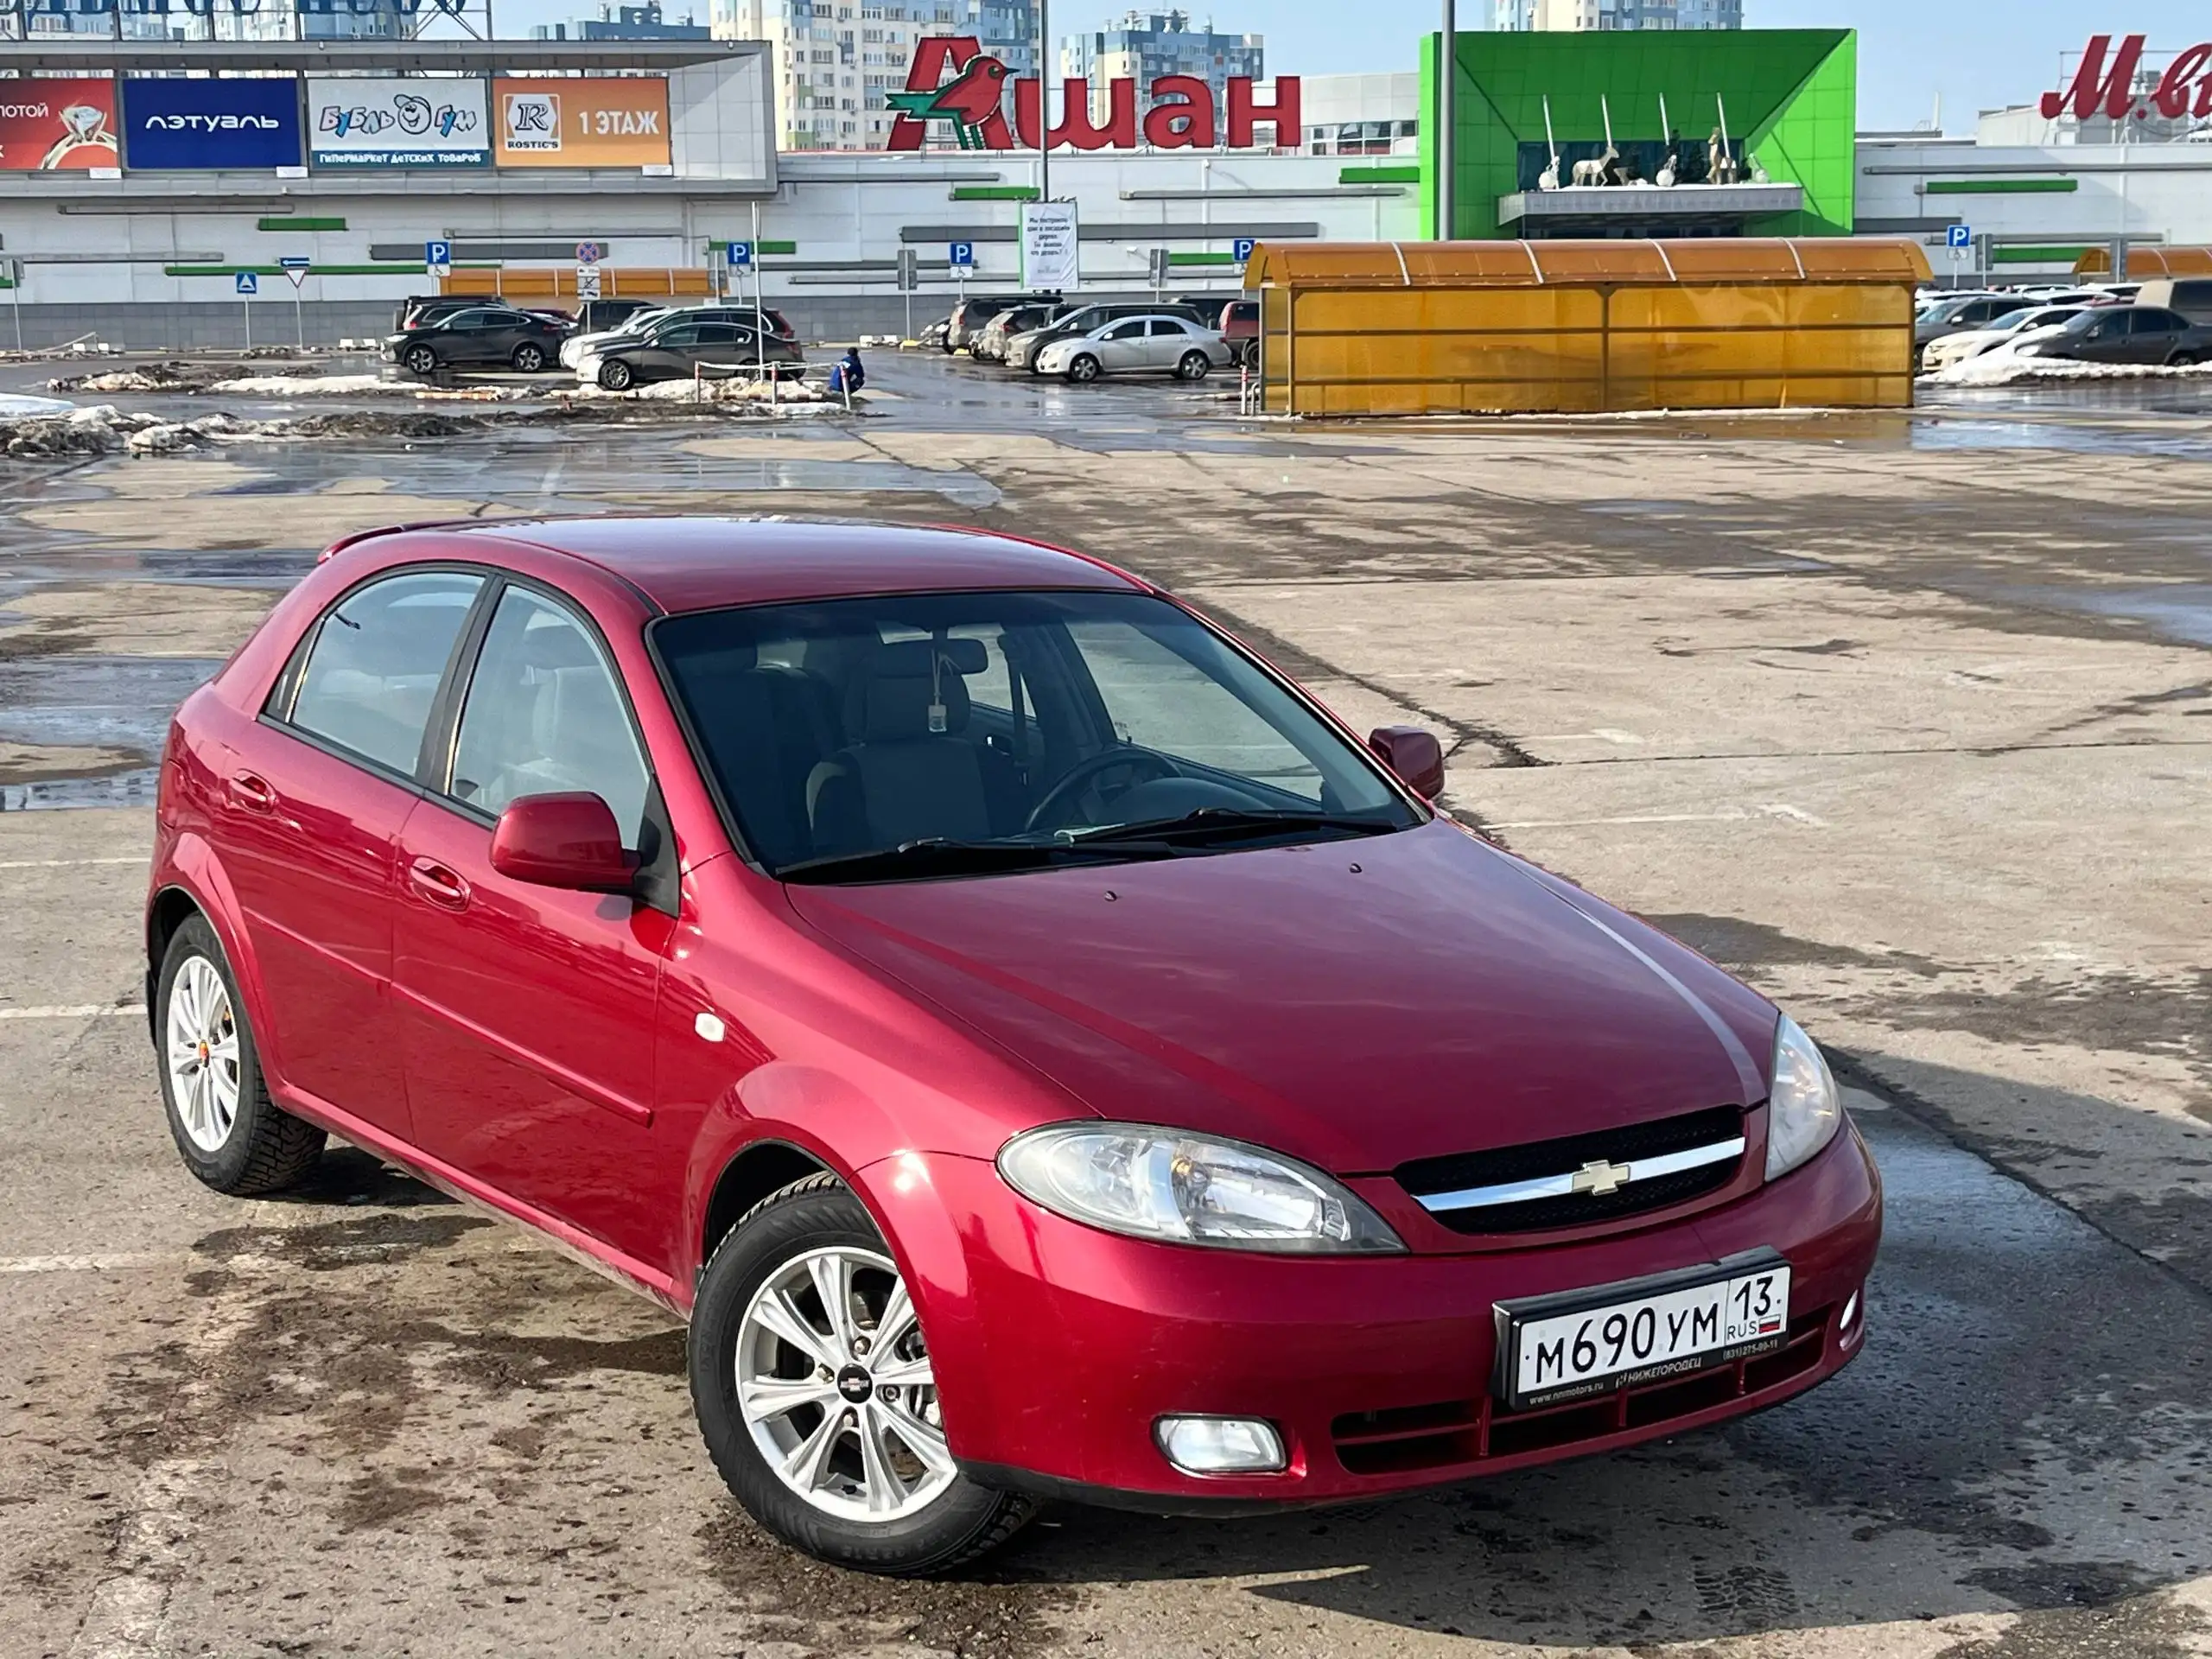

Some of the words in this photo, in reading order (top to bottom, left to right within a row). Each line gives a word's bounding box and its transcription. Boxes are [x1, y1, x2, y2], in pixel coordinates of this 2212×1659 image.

[579, 111, 588, 135] 1
[595, 110, 660, 135] ЭТАЖ
[1734, 1275, 1773, 1320] 13
[1728, 1322, 1757, 1341] RUS
